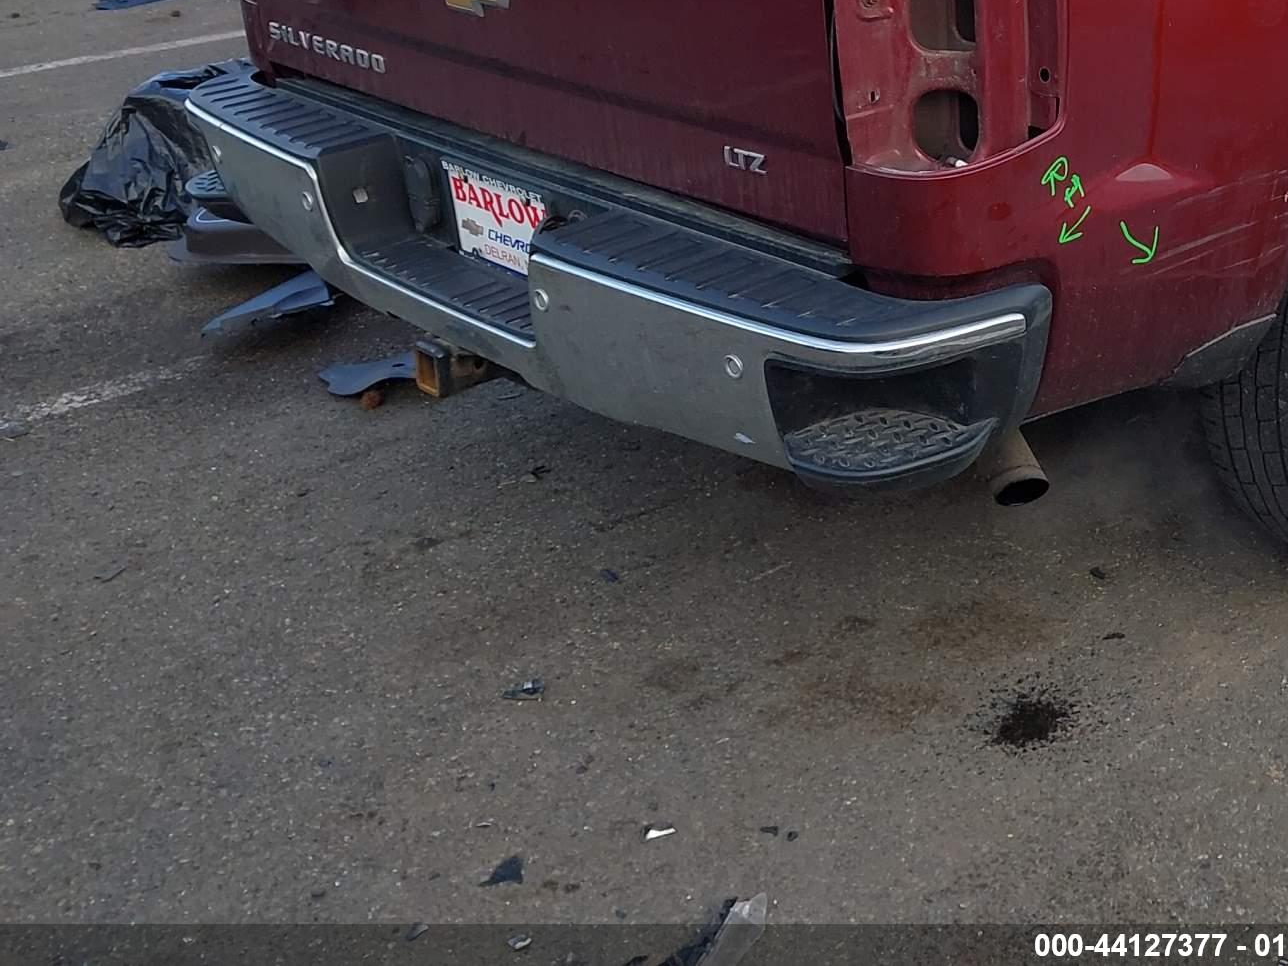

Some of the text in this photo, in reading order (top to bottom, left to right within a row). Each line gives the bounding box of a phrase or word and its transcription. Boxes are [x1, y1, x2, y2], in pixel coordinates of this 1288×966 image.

[268, 21, 386, 74] SILVERADO
[441, 160, 542, 204] BARLOW CHEVROLET
[723, 145, 767, 174] LTZ
[451, 176, 547, 229] BARLOW
